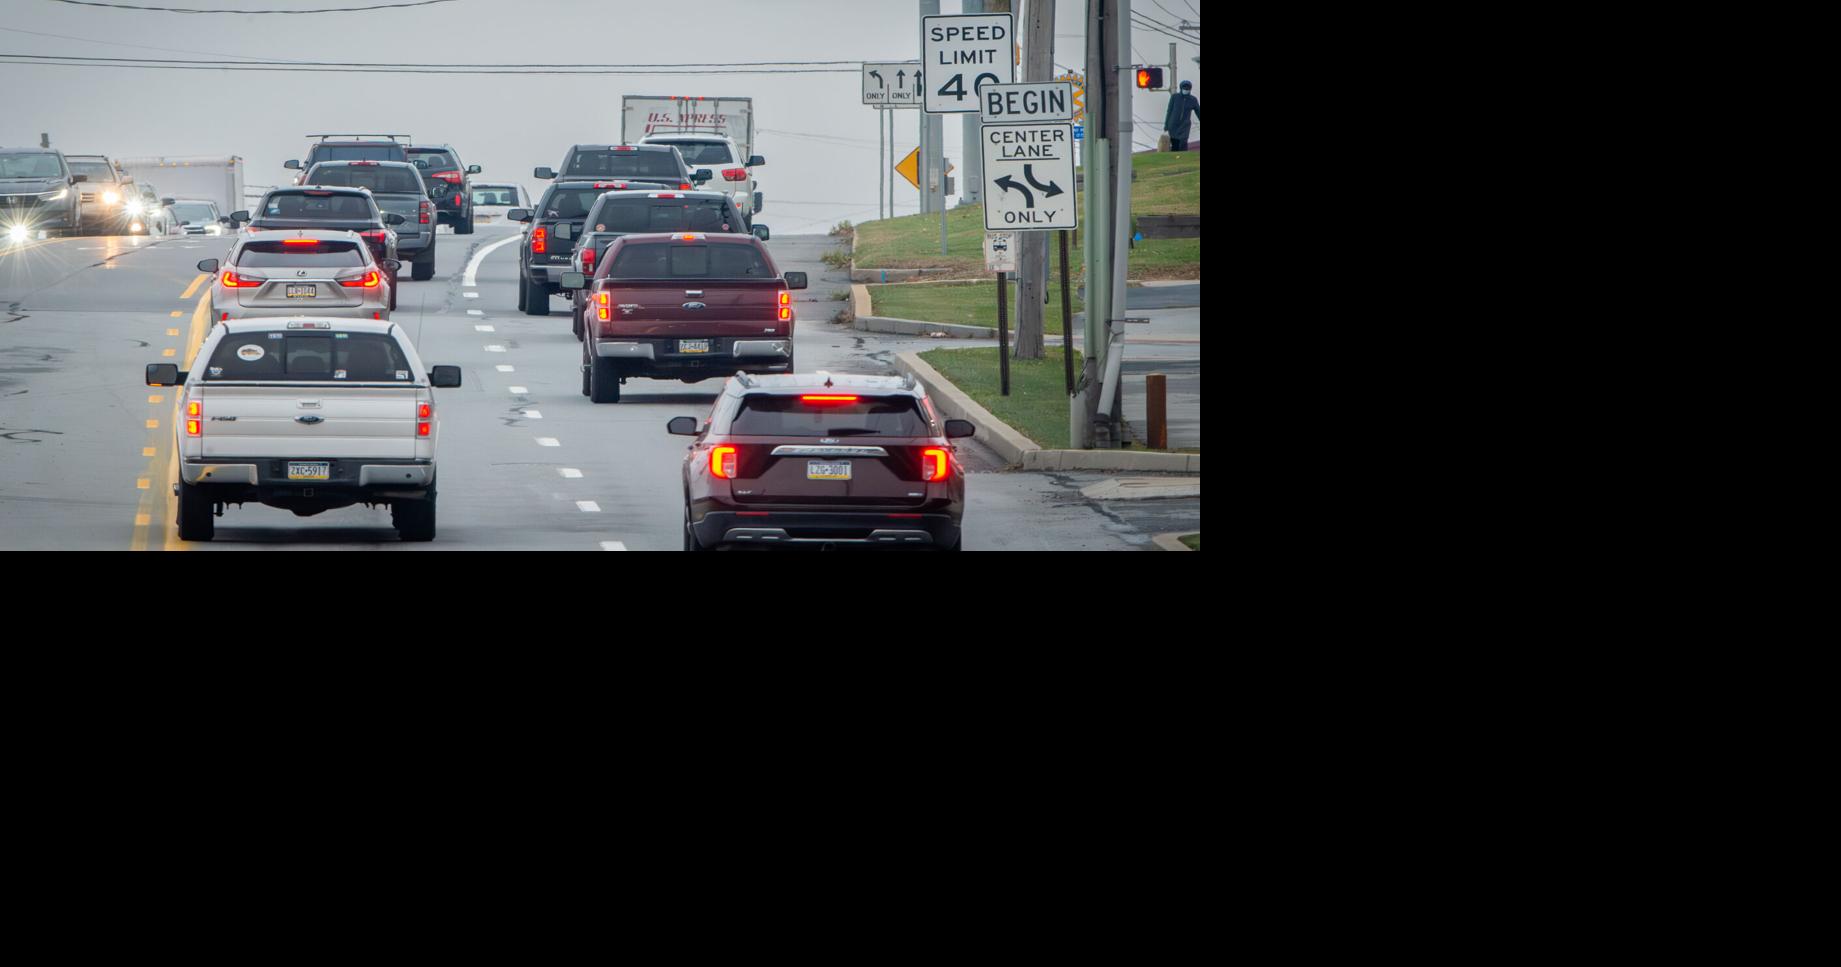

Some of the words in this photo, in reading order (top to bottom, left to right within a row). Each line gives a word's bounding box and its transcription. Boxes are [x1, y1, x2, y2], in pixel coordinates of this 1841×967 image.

[931, 26, 1006, 42] SPEED
[939, 49, 997, 65] LIMIT
[866, 92, 885, 100] ONLY
[891, 92, 911, 100] ONLY
[987, 90, 1065, 116] BEGIN
[648, 112, 673, 123] U.S.
[990, 129, 1065, 144] CENTER
[1002, 144, 1054, 158] LANE
[1004, 210, 1057, 224] ONLY
